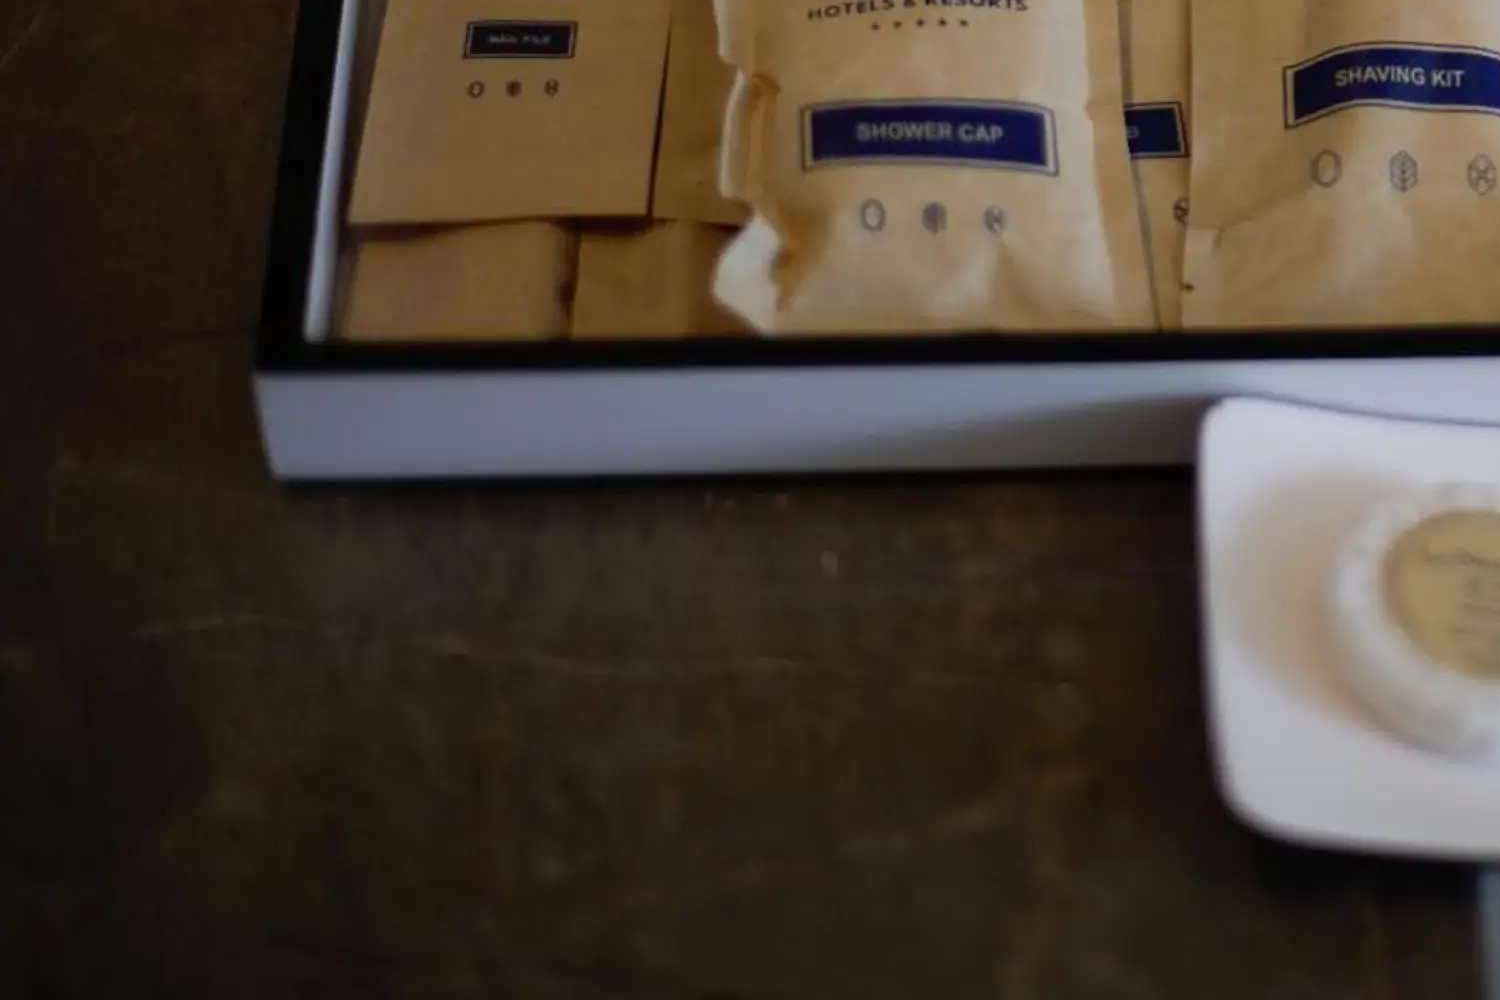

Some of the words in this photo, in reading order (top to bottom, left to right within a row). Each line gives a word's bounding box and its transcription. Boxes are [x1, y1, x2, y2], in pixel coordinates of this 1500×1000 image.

[1334, 65, 1426, 88] SHAVING
[1431, 68, 1465, 88] KIT
[856, 120, 952, 143] SHOWER
[958, 123, 1005, 145] CAP
